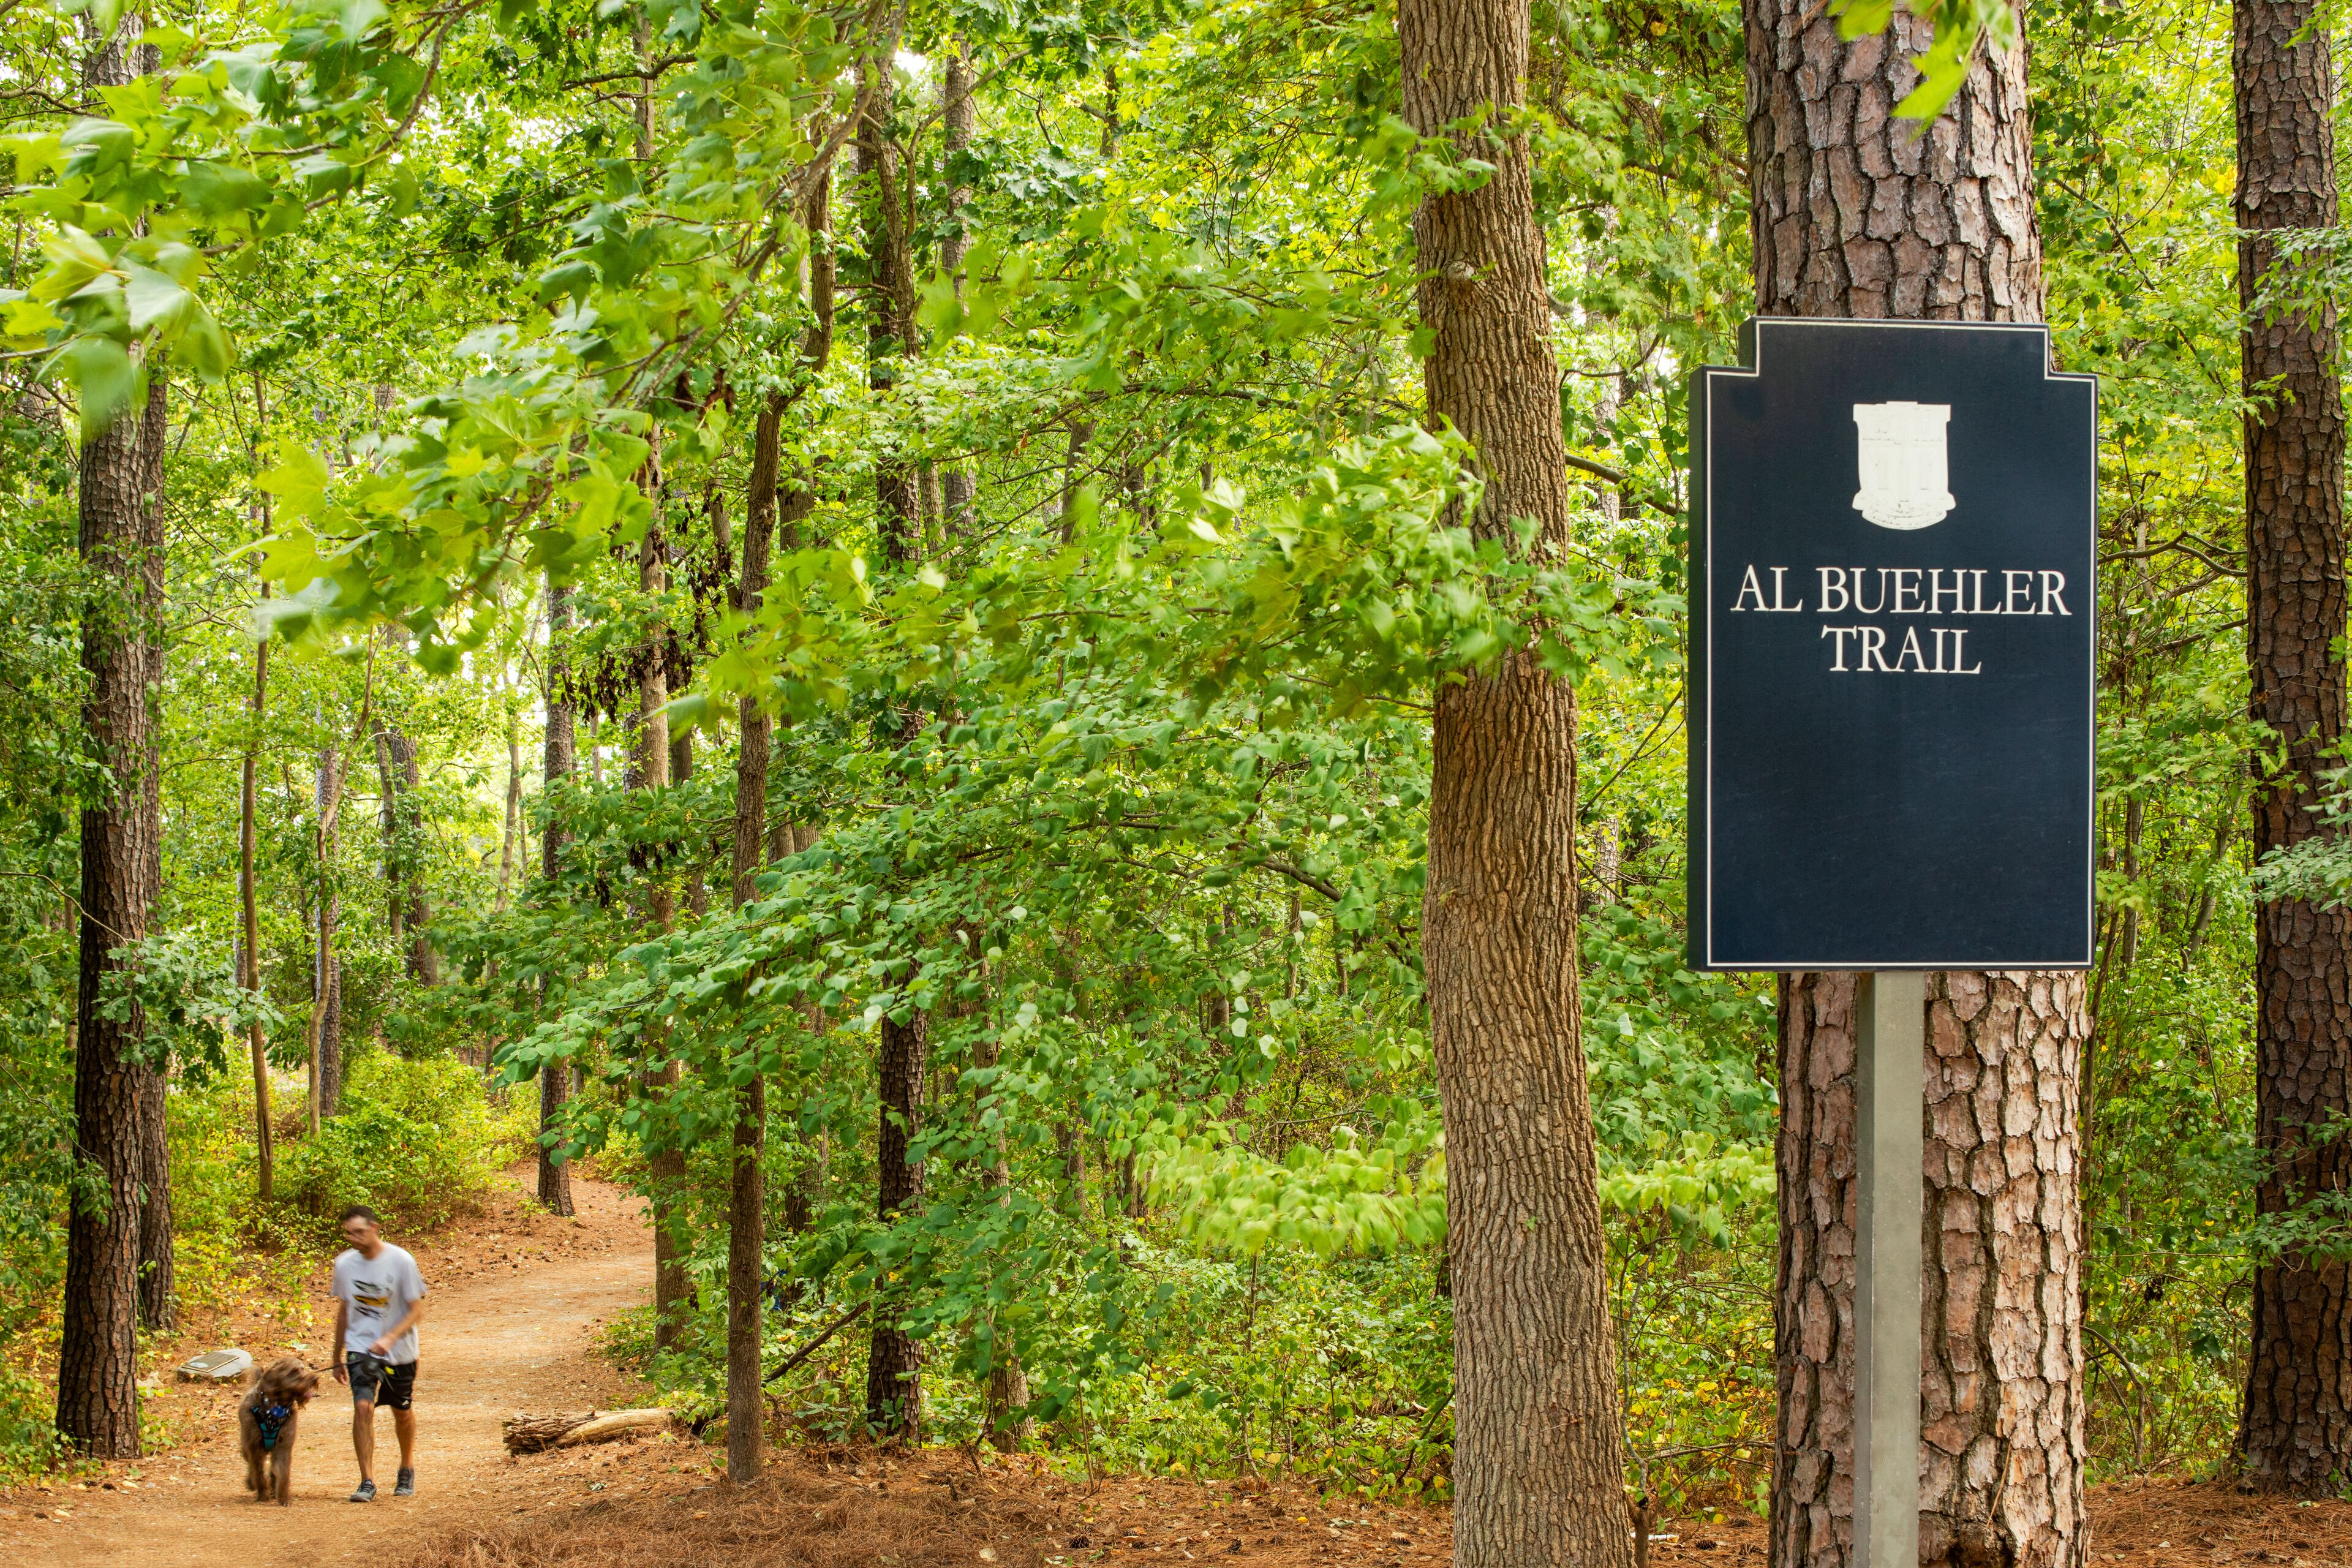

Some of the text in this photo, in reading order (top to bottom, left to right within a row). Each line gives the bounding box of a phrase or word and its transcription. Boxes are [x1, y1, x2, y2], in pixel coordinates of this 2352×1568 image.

[1730, 564, 2073, 616] AL BUEHLER
[1820, 625, 1982, 674] TRAIL
